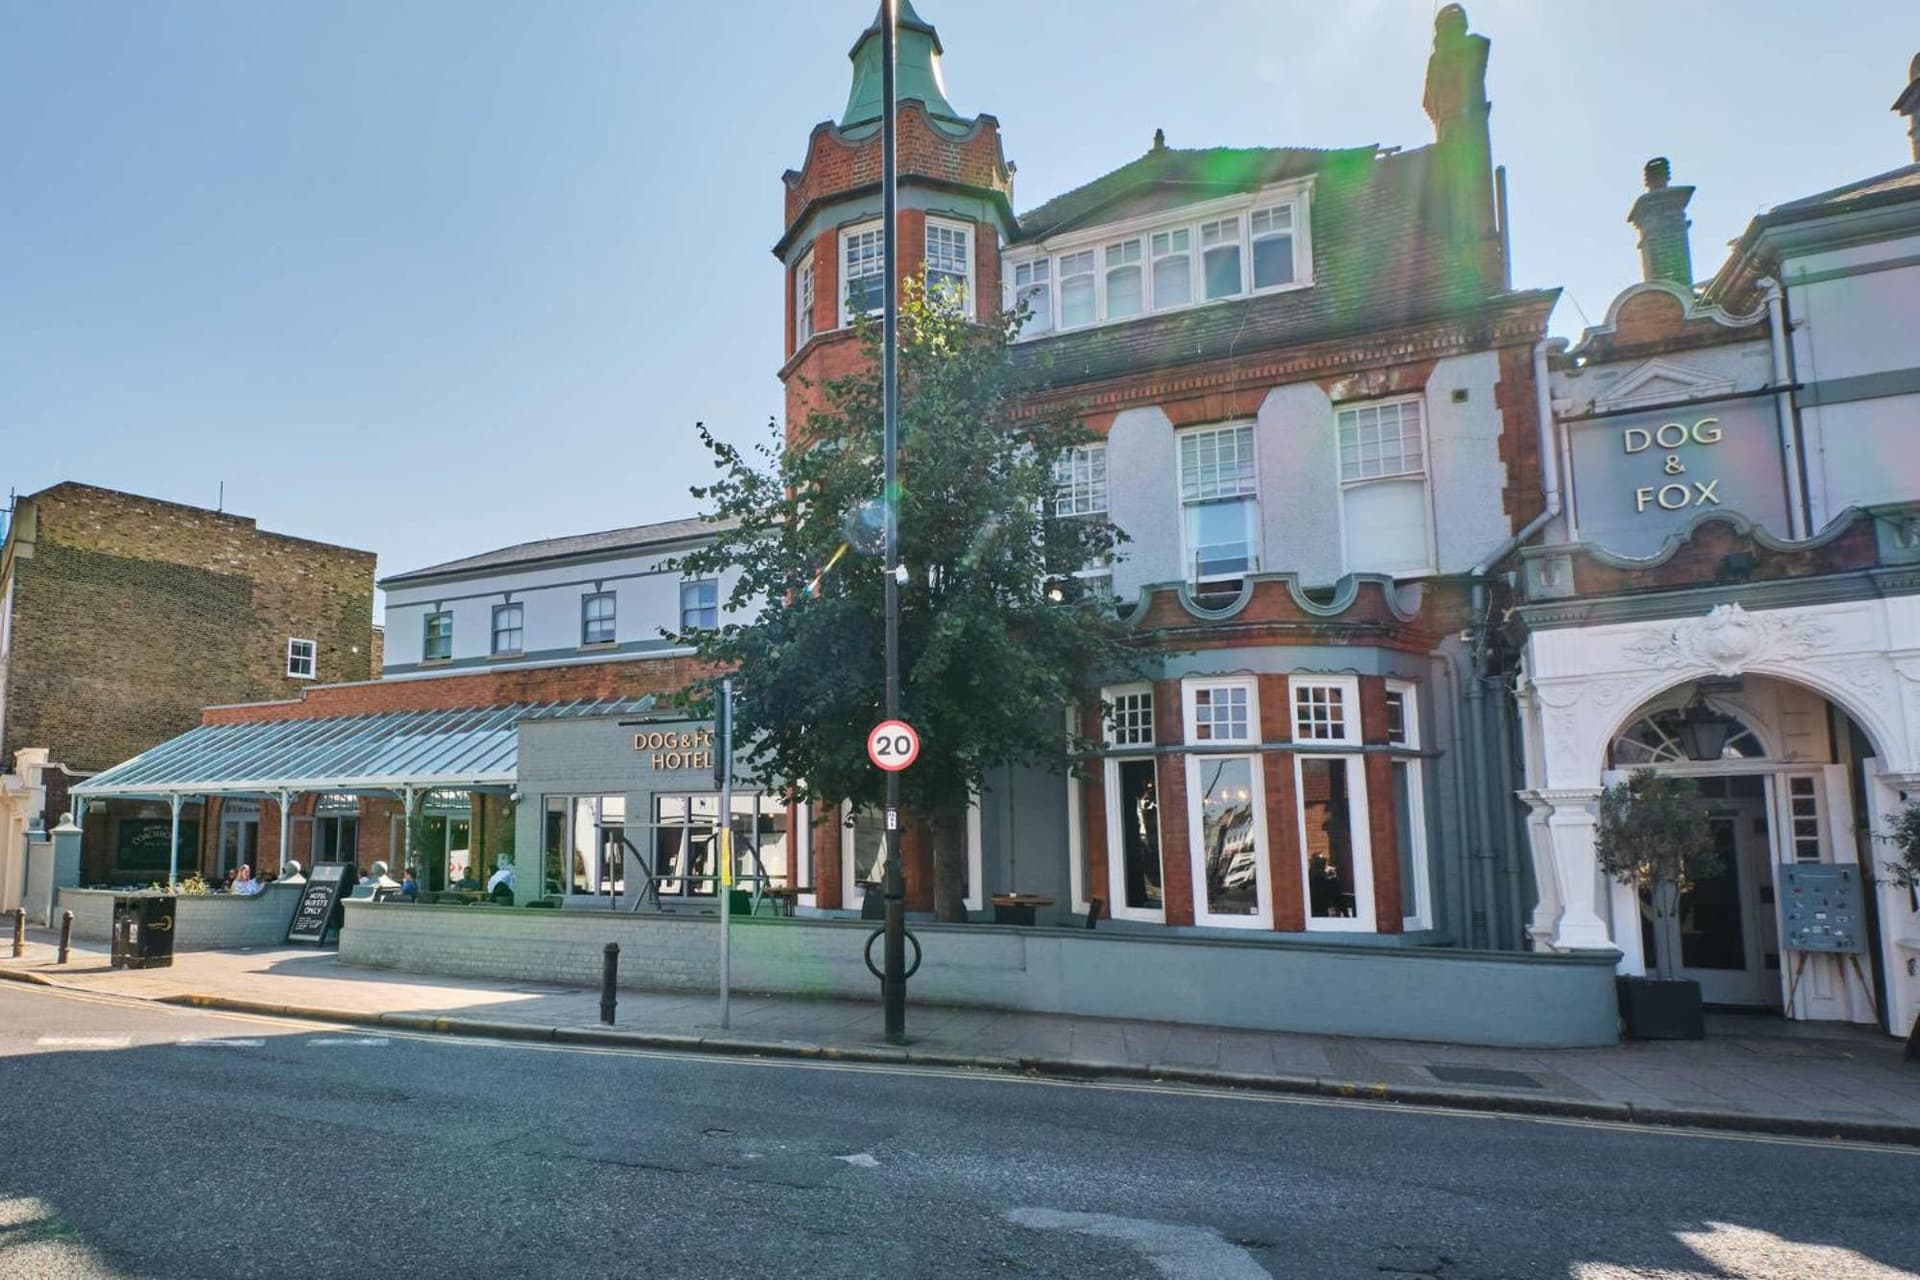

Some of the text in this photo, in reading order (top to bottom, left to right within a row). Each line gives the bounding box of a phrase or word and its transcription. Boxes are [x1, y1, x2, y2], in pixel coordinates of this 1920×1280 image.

[1624, 417, 1722, 453] DOG
[1664, 454, 1687, 475] &
[1636, 479, 1720, 512] FOX
[634, 731, 678, 750] DOG
[681, 734, 691, 748] &
[876, 735, 911, 756] 20
[651, 751, 713, 769] HOTEL
[304, 906, 322, 915] ONLY
